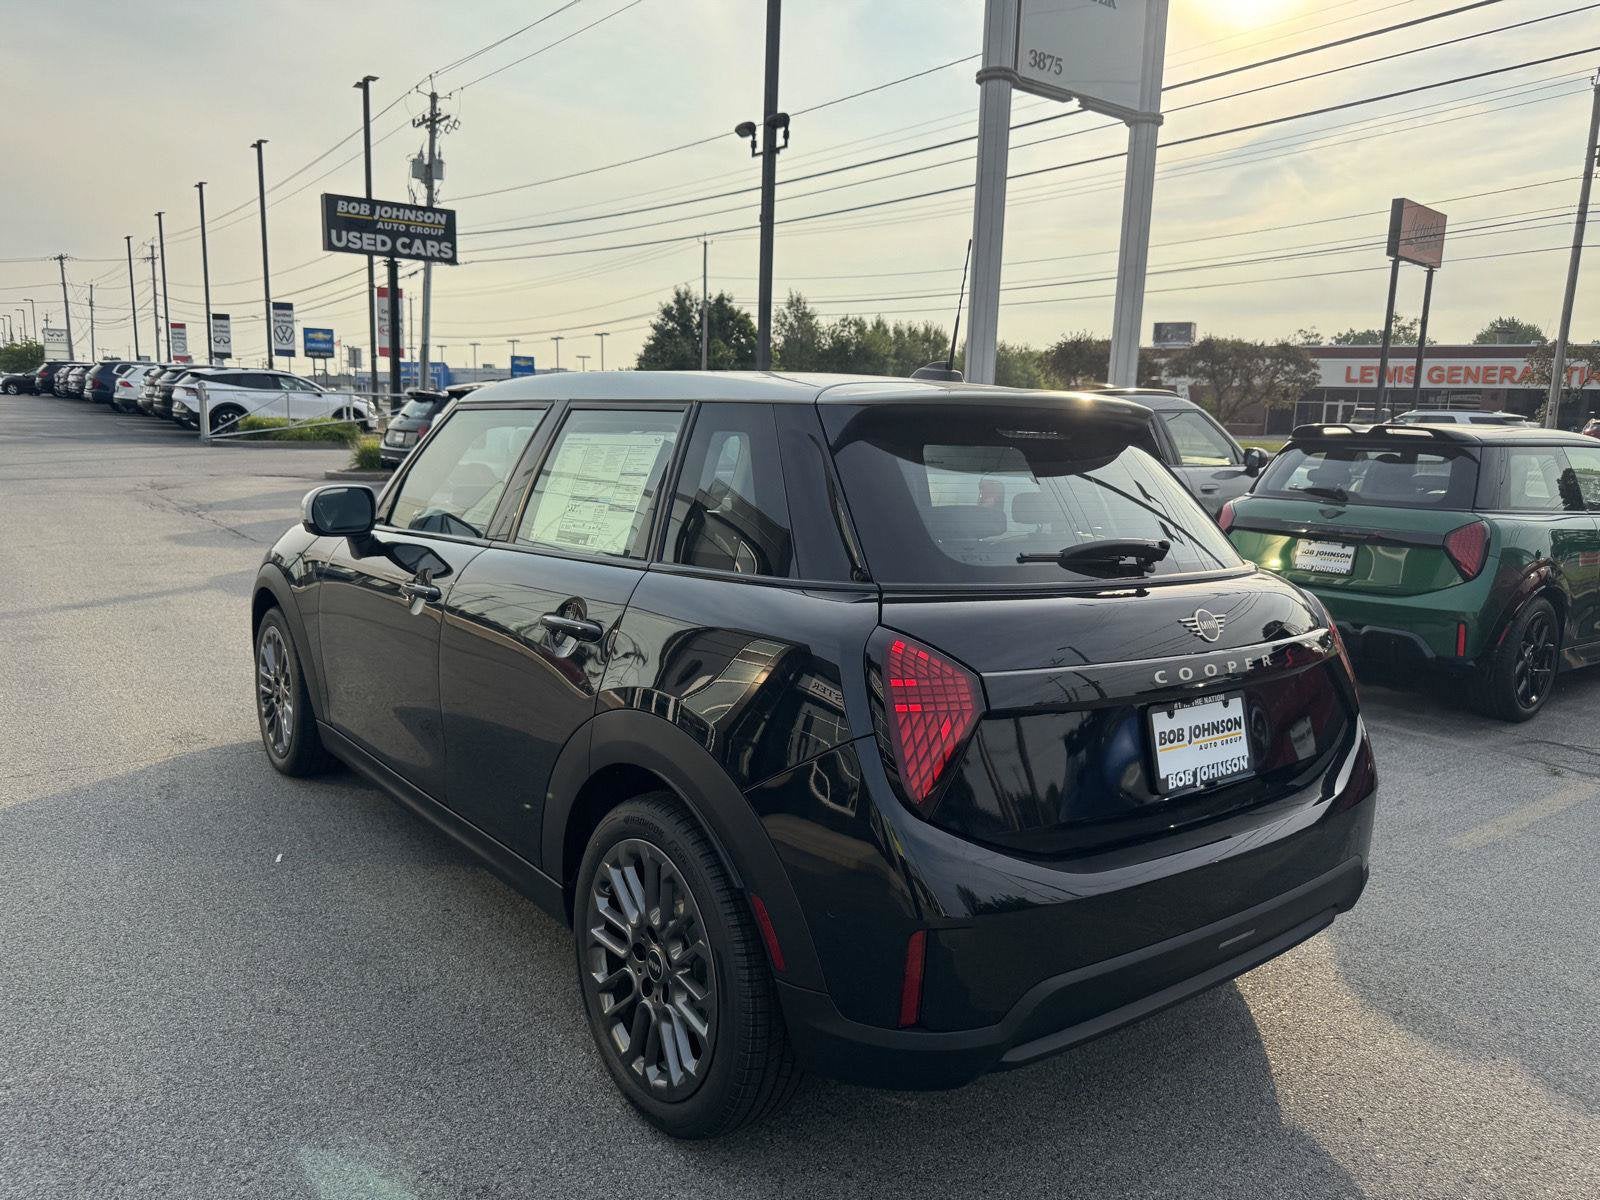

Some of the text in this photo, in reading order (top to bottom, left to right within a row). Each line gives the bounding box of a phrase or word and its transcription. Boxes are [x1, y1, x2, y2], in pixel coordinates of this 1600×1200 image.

[1029, 49, 1063, 76] 3875
[336, 200, 447, 225] BOB JOHNSON
[376, 221, 445, 236] AUTO GROUP
[330, 229, 453, 259] USED CARS
[1345, 365, 1417, 385] LEWIS
[1427, 365, 1536, 385] GENERA
[1316, 550, 1352, 559] JOHNSON
[1312, 564, 1347, 574] JOHNSON
[1199, 619, 1217, 631] MINI
[1154, 650, 1295, 684] COOPER S
[1203, 694, 1225, 704] NATION
[1158, 716, 1242, 747] BOB JOHNSON
[1199, 736, 1242, 751] AUTO GROUP
[1167, 755, 1248, 790] BOB JOHNSON
